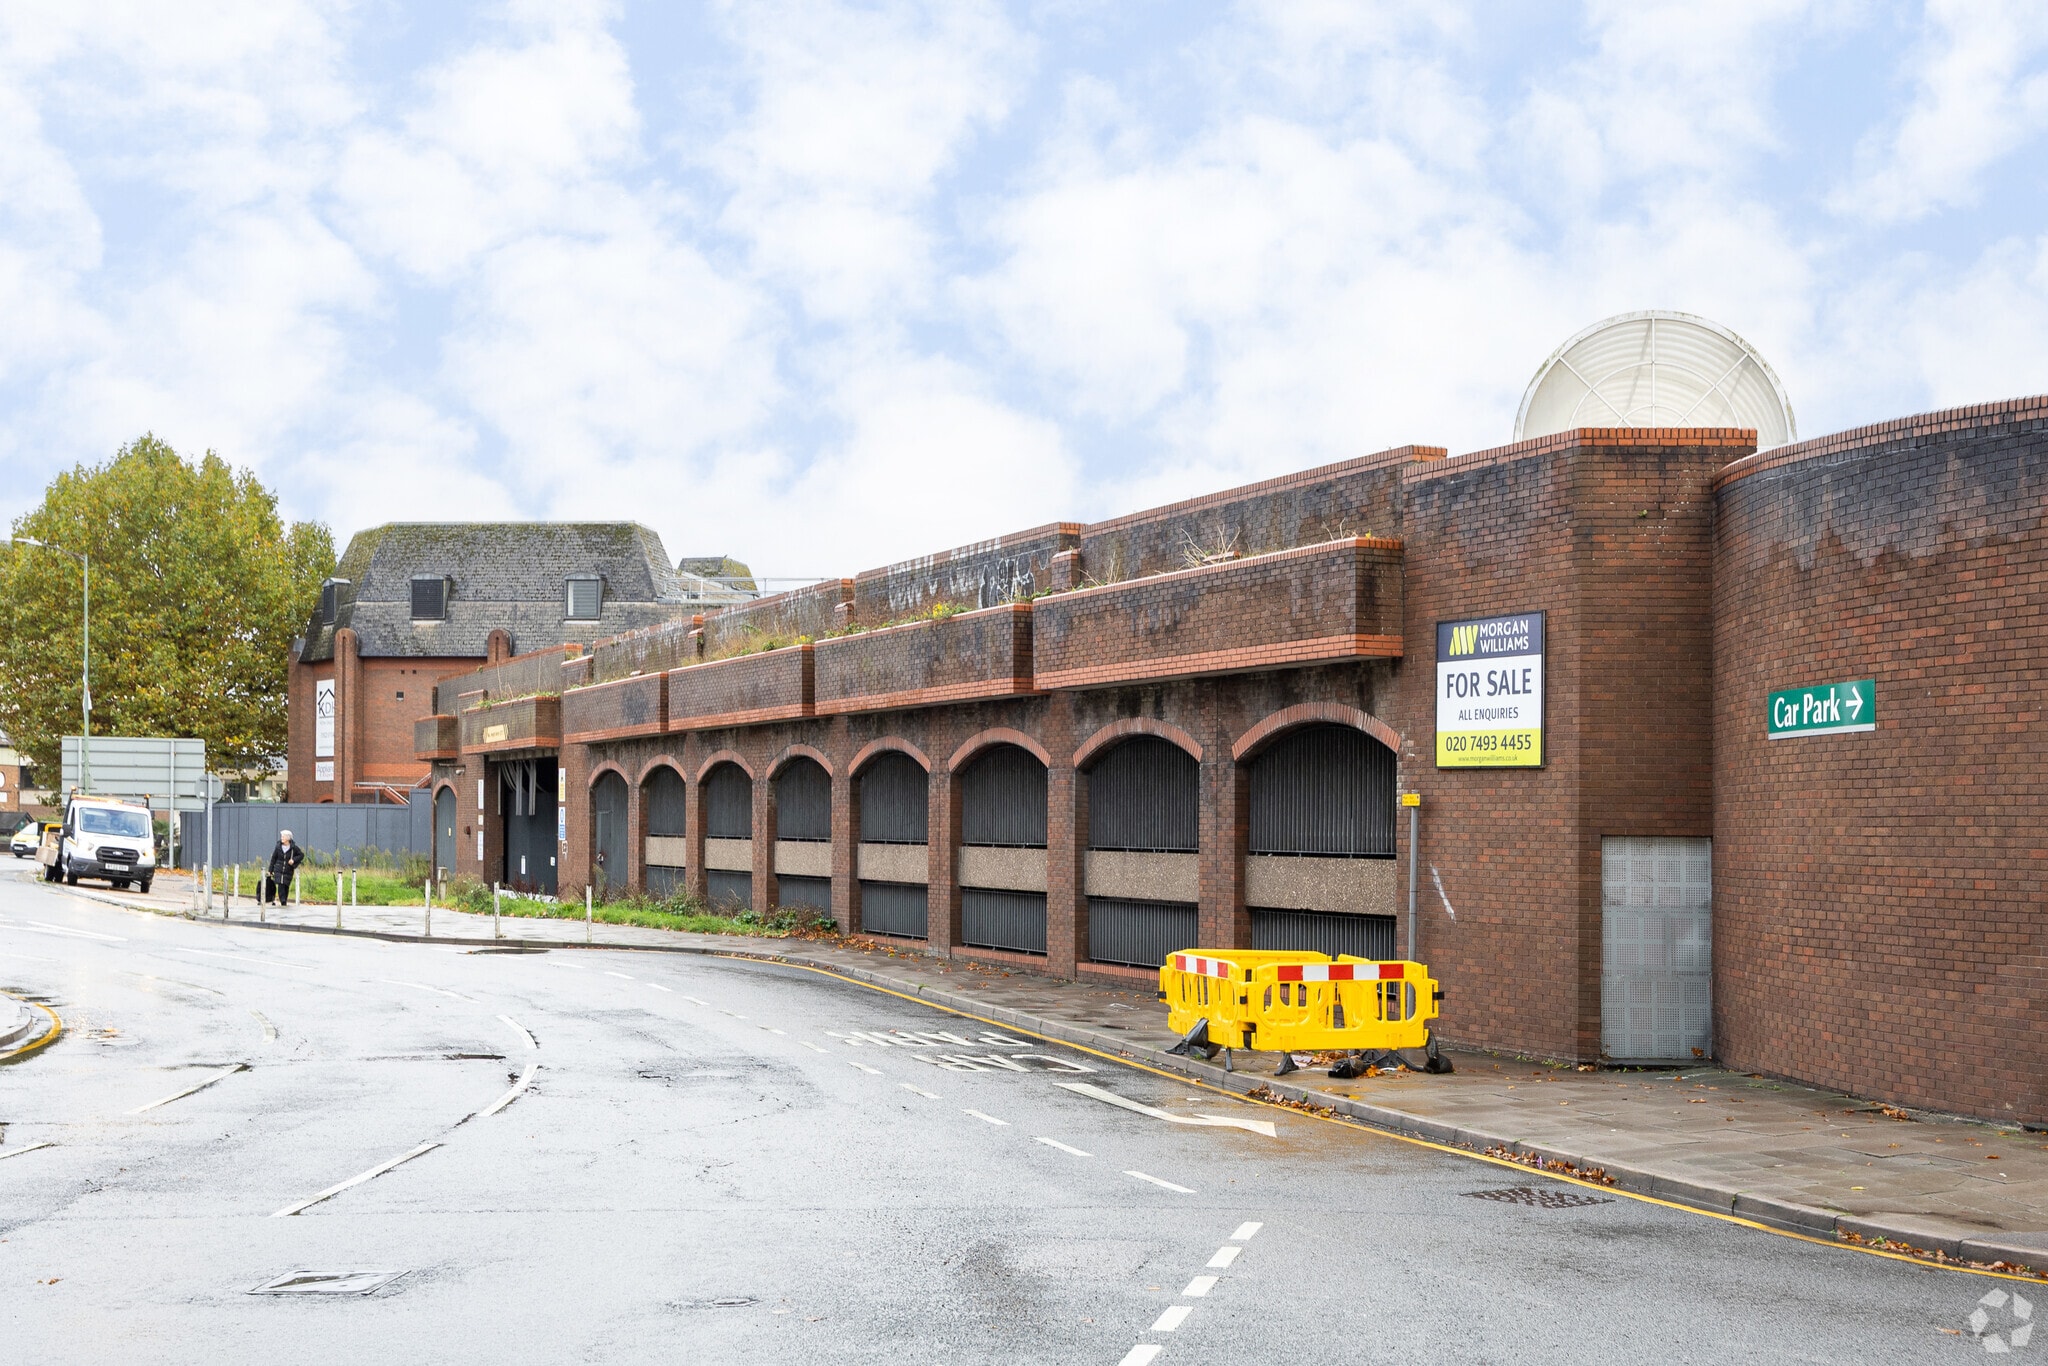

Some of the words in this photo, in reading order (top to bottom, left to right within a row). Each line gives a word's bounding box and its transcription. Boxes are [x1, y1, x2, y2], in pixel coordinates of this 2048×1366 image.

[1480, 620, 1529, 638] MORGAN
[1480, 636, 1529, 653] WILLIAMS
[1447, 672, 1480, 698] FOR
[1487, 668, 1532, 697] SALE
[1459, 709, 1472, 721] ALL
[1475, 706, 1519, 722] ENQUIRIES
[1774, 697, 1799, 728] Car
[1803, 687, 1840, 724] Park
[1446, 736, 1467, 752] 020
[1470, 735, 1498, 751] 7493
[1500, 734, 1532, 750] 4455
[824, 1031, 1034, 1047] PARK
[911, 1053, 1097, 1073] CAR
